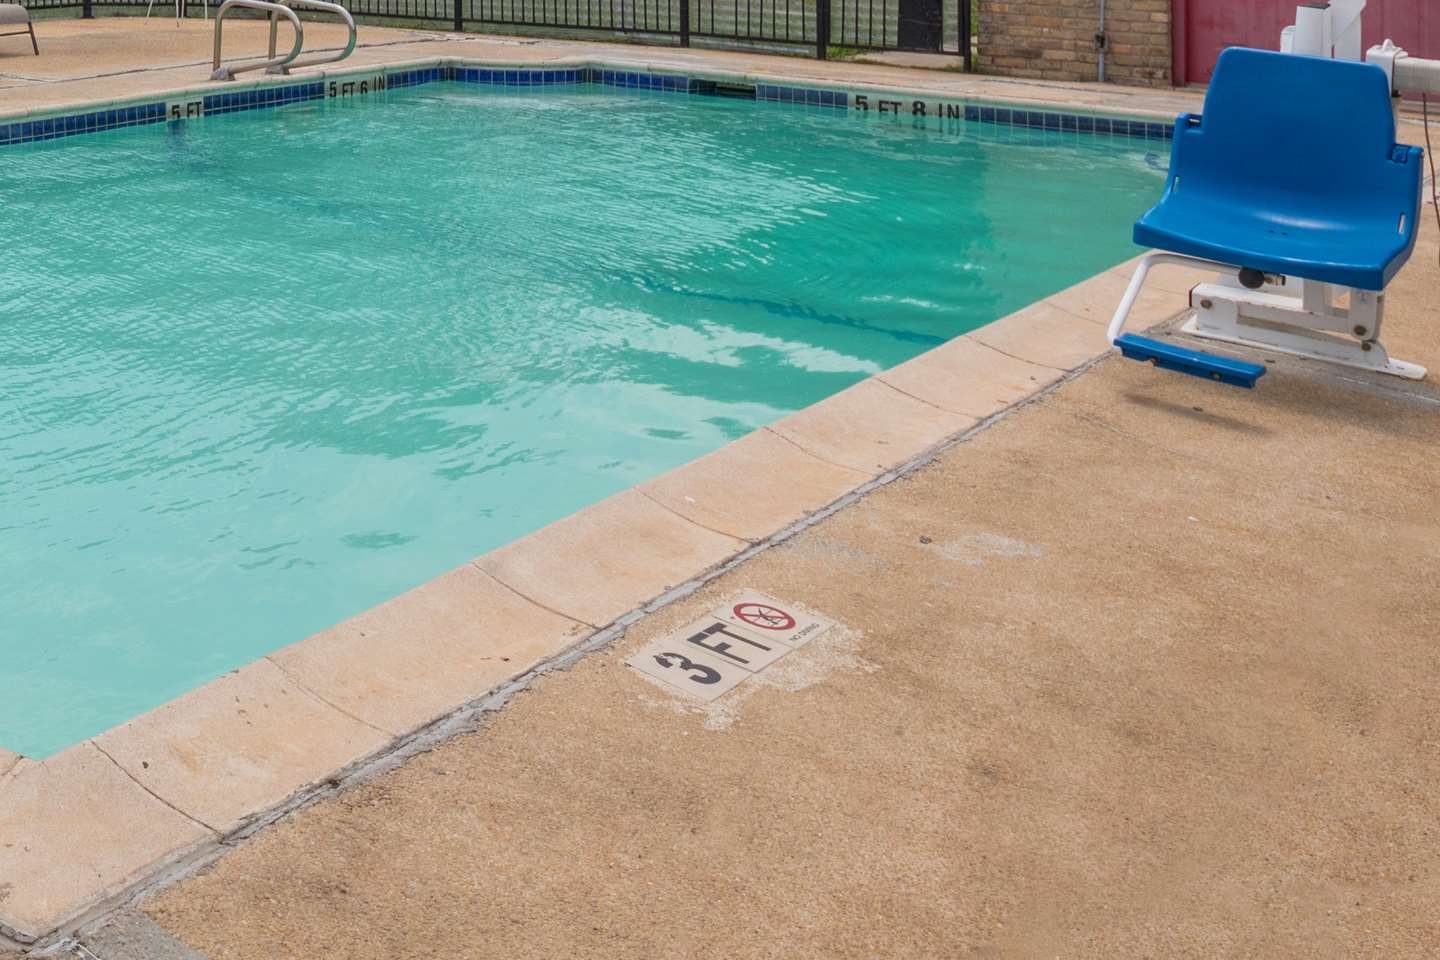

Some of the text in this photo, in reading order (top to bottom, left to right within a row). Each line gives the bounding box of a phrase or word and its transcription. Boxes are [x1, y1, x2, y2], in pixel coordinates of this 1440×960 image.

[329, 80, 336, 97] 5
[342, 81, 356, 97] FT
[373, 75, 385, 91] IN
[171, 101, 202, 118] 5 FT
[855, 94, 960, 119] 5 FT 8 IN
[653, 621, 772, 685] 3 FT
